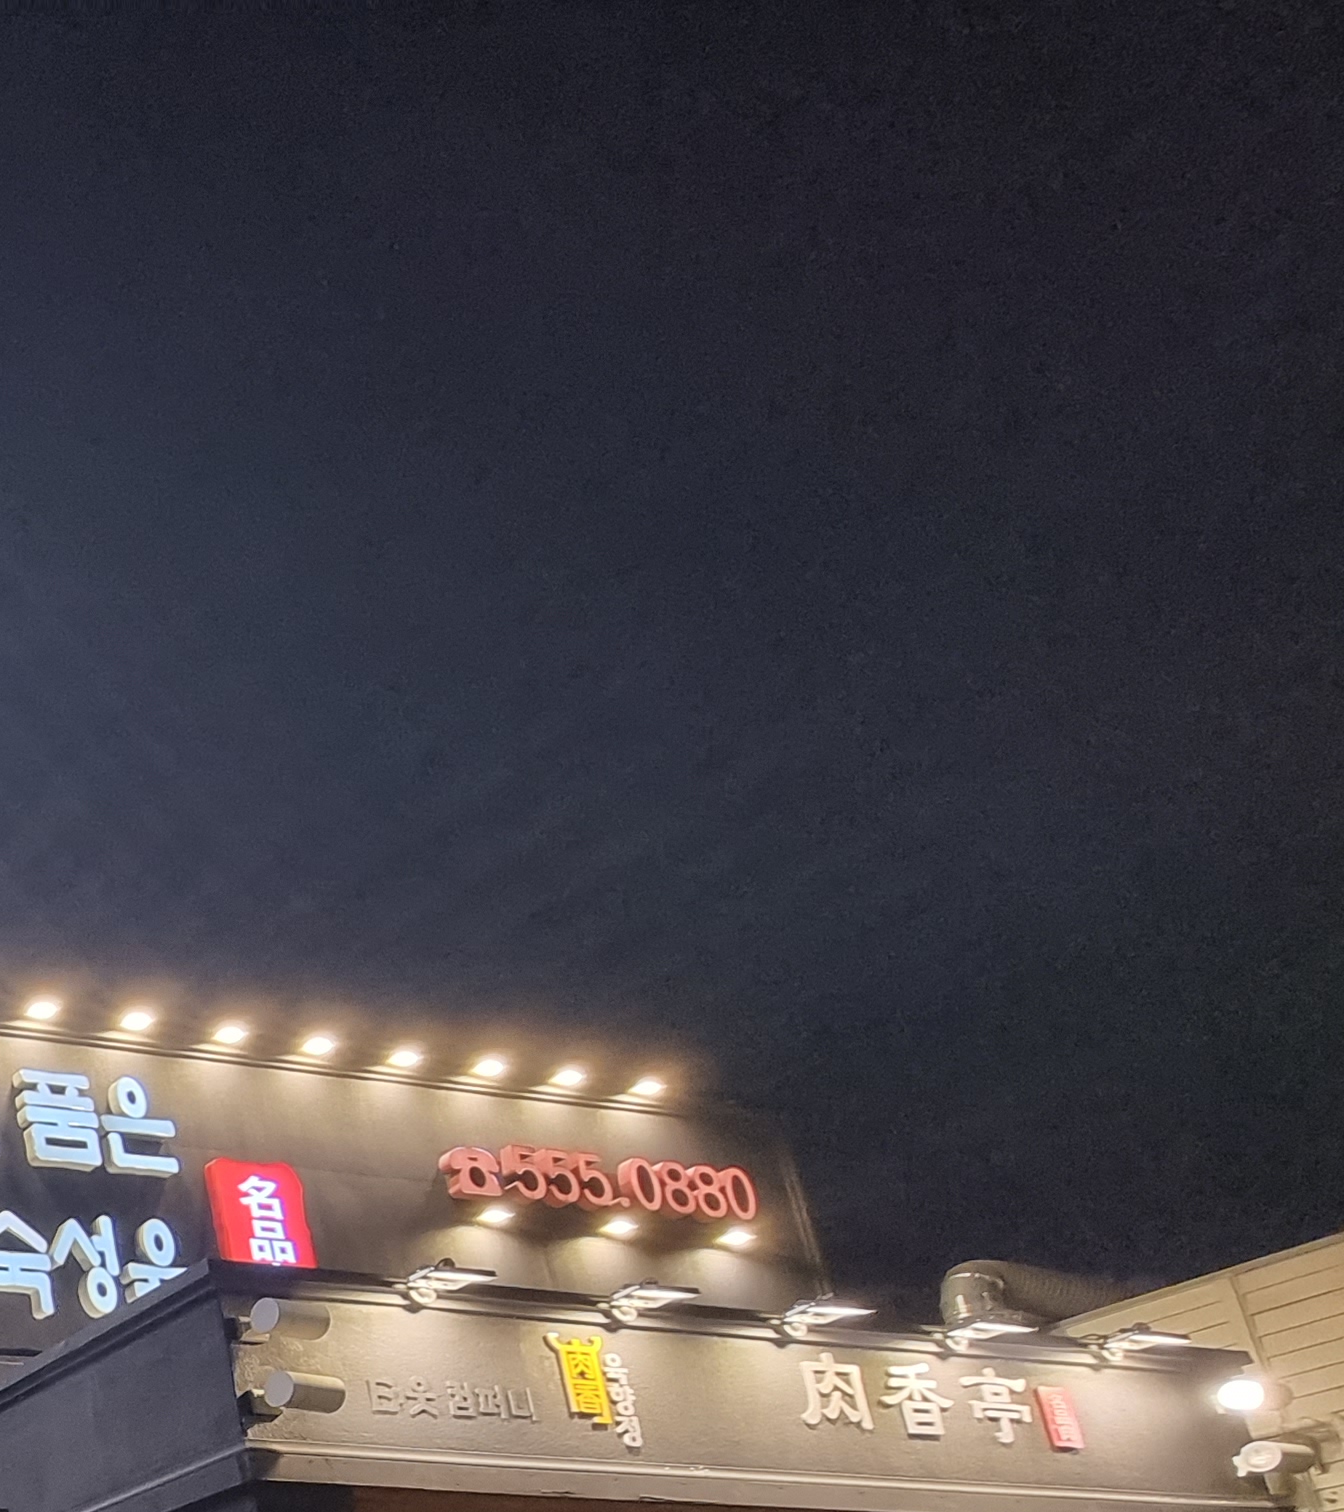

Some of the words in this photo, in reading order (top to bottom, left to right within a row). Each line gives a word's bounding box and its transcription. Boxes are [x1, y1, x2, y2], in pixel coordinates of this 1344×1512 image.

[13, 1069, 180, 1178] 품은
[602, 1353, 643, 1447] 육향정
[799, 1351, 1034, 1445] 肉香亭
